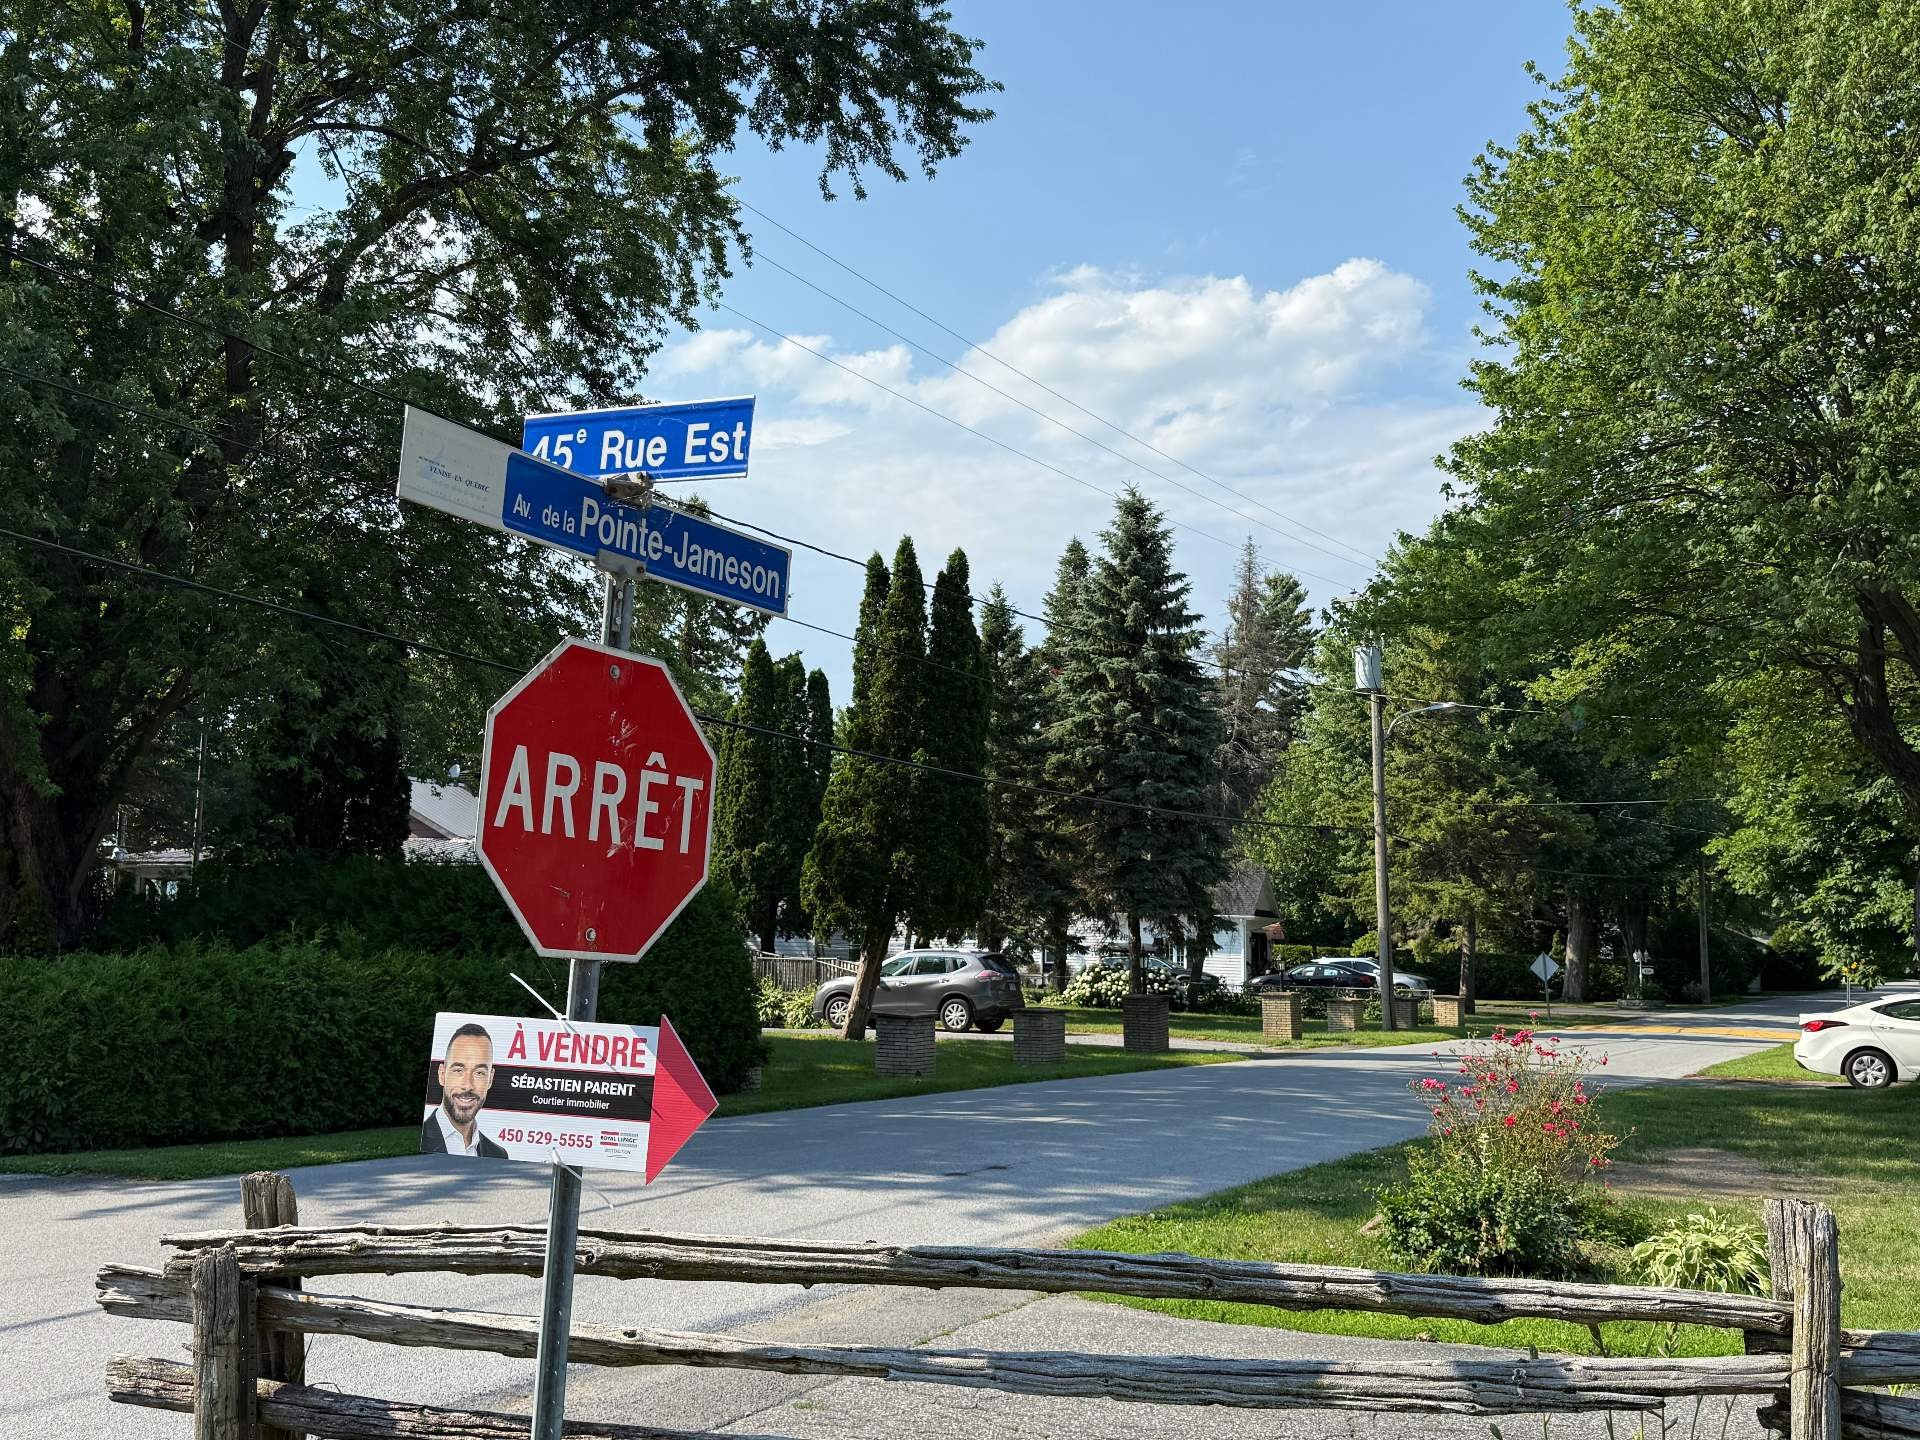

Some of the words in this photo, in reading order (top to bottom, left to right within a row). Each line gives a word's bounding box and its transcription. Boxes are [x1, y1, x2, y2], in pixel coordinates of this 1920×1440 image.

[600, 430, 667, 469] Rue
[684, 421, 746, 464] Est
[513, 493, 531, 520] Av.
[542, 505, 559, 529] de
[562, 509, 575, 533] la
[579, 496, 780, 600] Pointe-Jameson
[493, 744, 704, 854] ARRÊT
[508, 1023, 526, 1060] À
[538, 1031, 648, 1068] VENDRE
[511, 1073, 581, 1093] SÉBASTIEN
[584, 1081, 636, 1097] PARENT
[532, 1095, 565, 1107] Courtier
[566, 1097, 610, 1110] immobilier
[498, 1128, 524, 1143] 450
[527, 1130, 593, 1149] 529-5555
